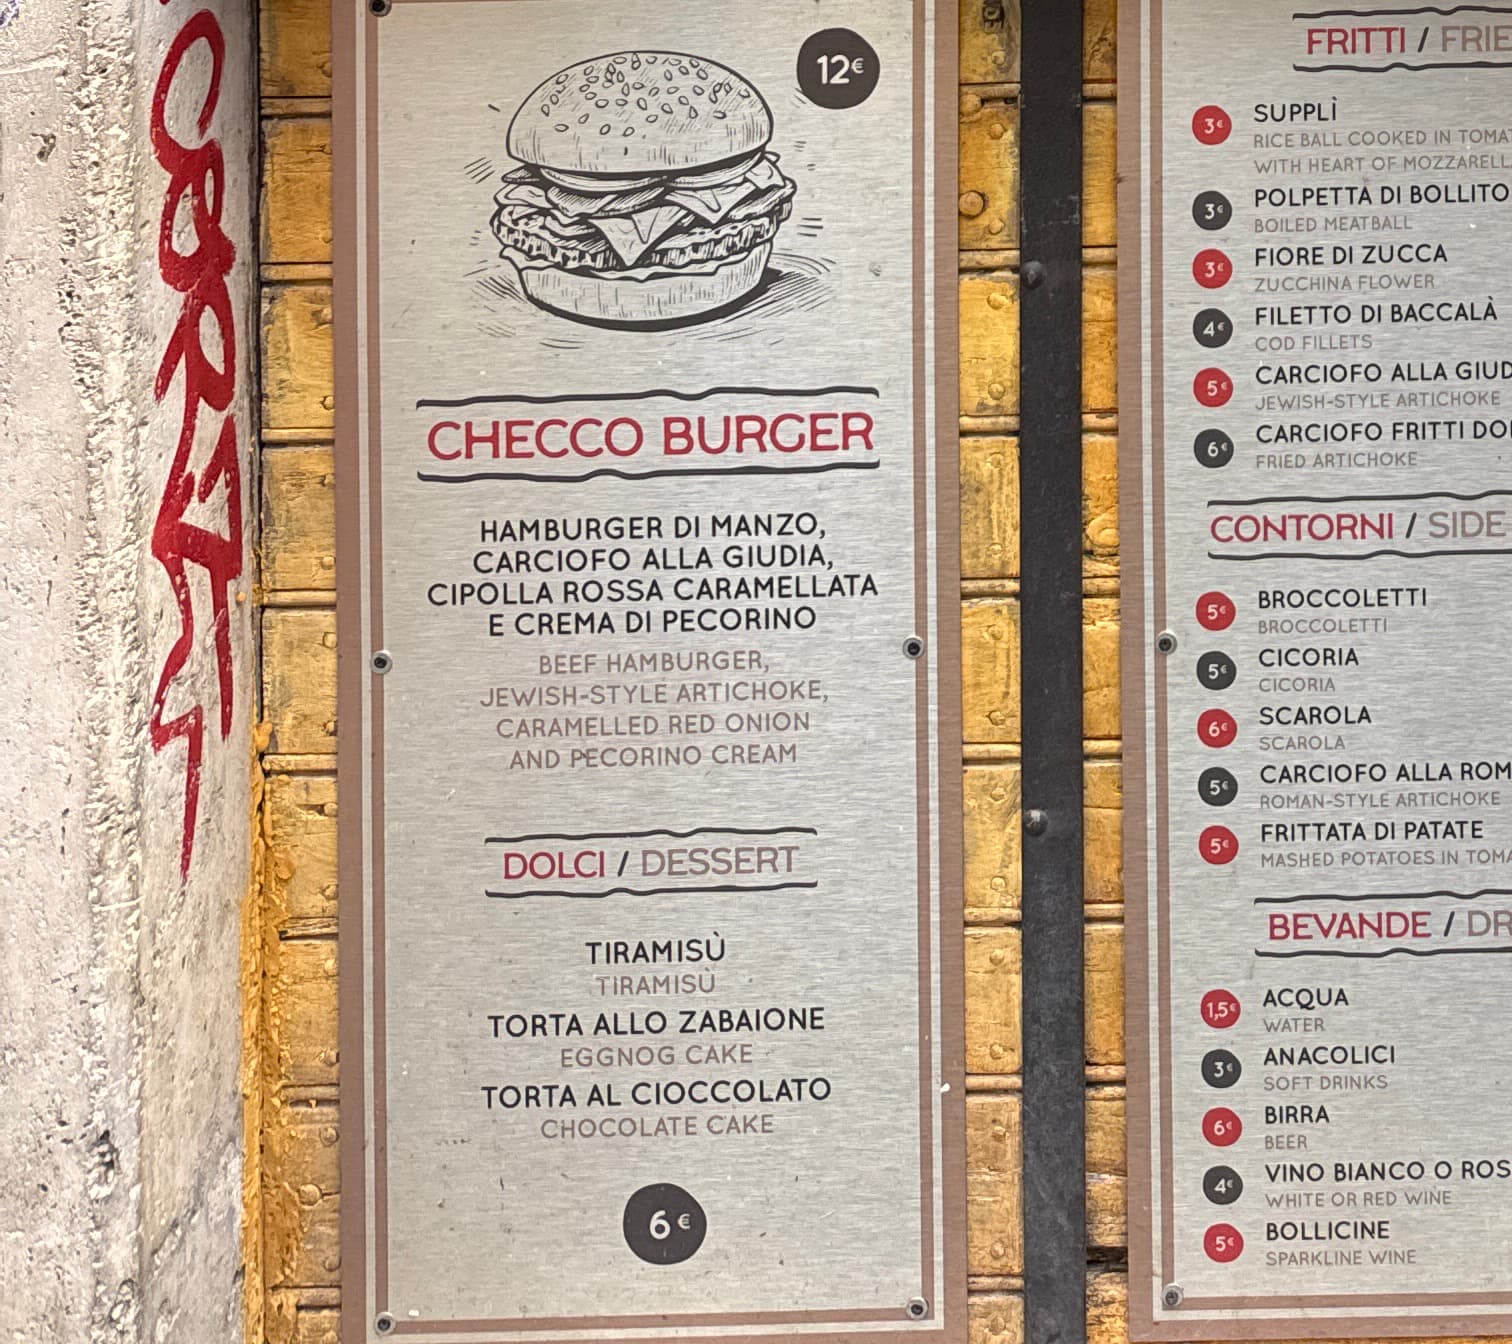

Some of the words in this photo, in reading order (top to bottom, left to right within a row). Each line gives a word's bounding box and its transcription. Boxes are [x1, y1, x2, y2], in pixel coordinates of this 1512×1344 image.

[1307, 28, 1406, 55] FRITTI
[1254, 97, 1336, 123] SUPPLÌ
[1253, 133, 1295, 148] RICE
[1300, 132, 1342, 147] BALL
[1347, 130, 1427, 146] COOKED
[1434, 130, 1451, 145] IN
[1255, 246, 1324, 266] FIORE
[1333, 246, 1353, 265] DI
[1362, 243, 1447, 264] ZUCCA
[1255, 305, 1352, 326] FILETTO
[1361, 304, 1382, 324] DI
[1391, 296, 1497, 323] BACCALÀ
[1254, 336, 1295, 352] COD
[1302, 333, 1372, 351] FILLETS
[1255, 363, 1382, 385] CARCIOFO
[1391, 362, 1447, 381] ALLA
[428, 417, 643, 460] CHECCO
[664, 412, 873, 455] BURGER
[481, 516, 663, 542] HAMBURGER
[674, 516, 699, 538] DI
[712, 512, 825, 538] MANZO,
[1210, 513, 1393, 543] CONTORNI
[1430, 512, 1504, 537] SIDE
[428, 582, 553, 606] CIPOLLA
[563, 579, 663, 603] ROSSA
[674, 574, 878, 601] CARAMELLATA
[1258, 648, 1359, 667] CICORIA
[480, 684, 667, 708] JEWISH-STYLE
[676, 679, 828, 703] ARTICHOKE,
[1259, 705, 1371, 725] SCAROLA
[504, 850, 605, 880] DOLCI
[642, 846, 799, 876] DESSERT
[1269, 912, 1431, 940] BEVANDE
[585, 931, 725, 964] TIRAMISÙ
[596, 967, 715, 996] TIRAMISÙ
[1263, 988, 1349, 1011] ACQUA
[488, 1014, 583, 1037] TORTA
[593, 1011, 667, 1035] ALLO
[679, 1007, 824, 1034] ZABAIONE
[1263, 1017, 1325, 1033] WATER
[1264, 1045, 1395, 1065] ANACOLICI
[541, 1116, 697, 1139] CHOCOLATE
[706, 1114, 774, 1135] CAKE
[1265, 1105, 1329, 1125] BIRRA
[1264, 1134, 1307, 1151] BEER
[1266, 1221, 1389, 1241] BOLLICINE
